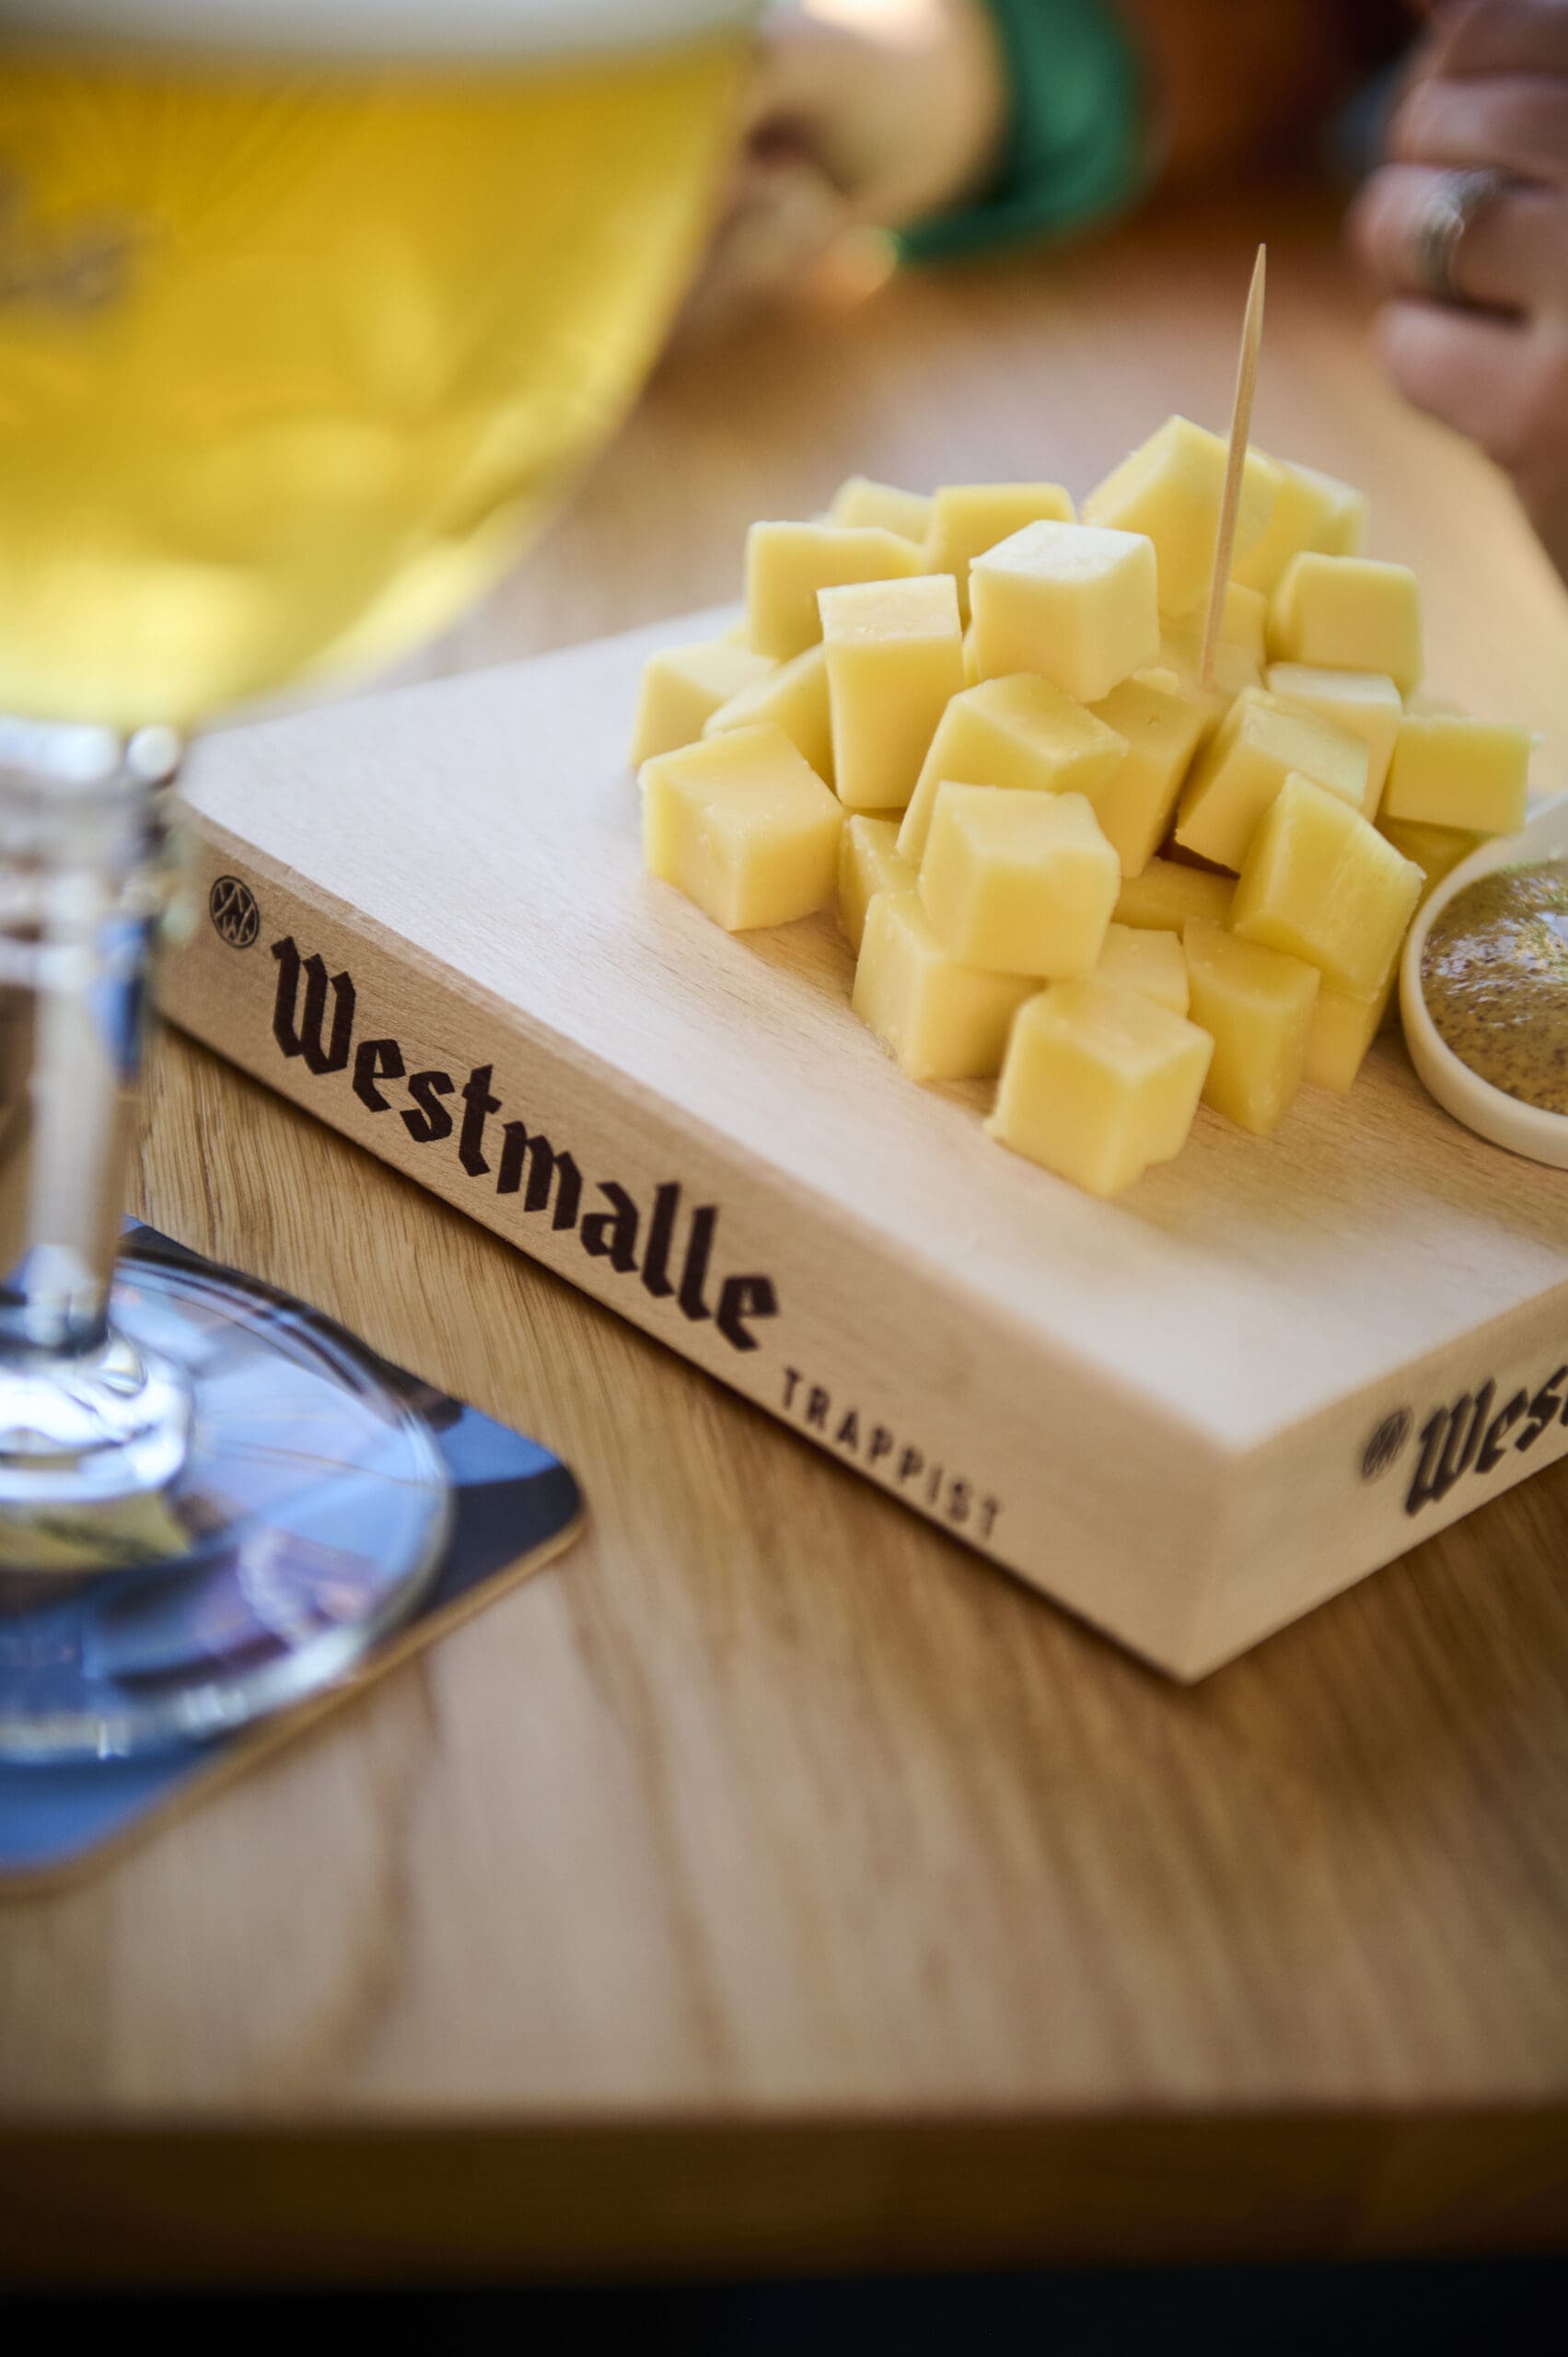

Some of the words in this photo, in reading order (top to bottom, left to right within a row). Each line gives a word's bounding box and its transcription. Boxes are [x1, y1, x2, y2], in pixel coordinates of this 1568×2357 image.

[270, 935, 779, 1352] Westmalle
[782, 1365, 1002, 1540] TRAPPIST
[1404, 1364, 1568, 1517] Wes
